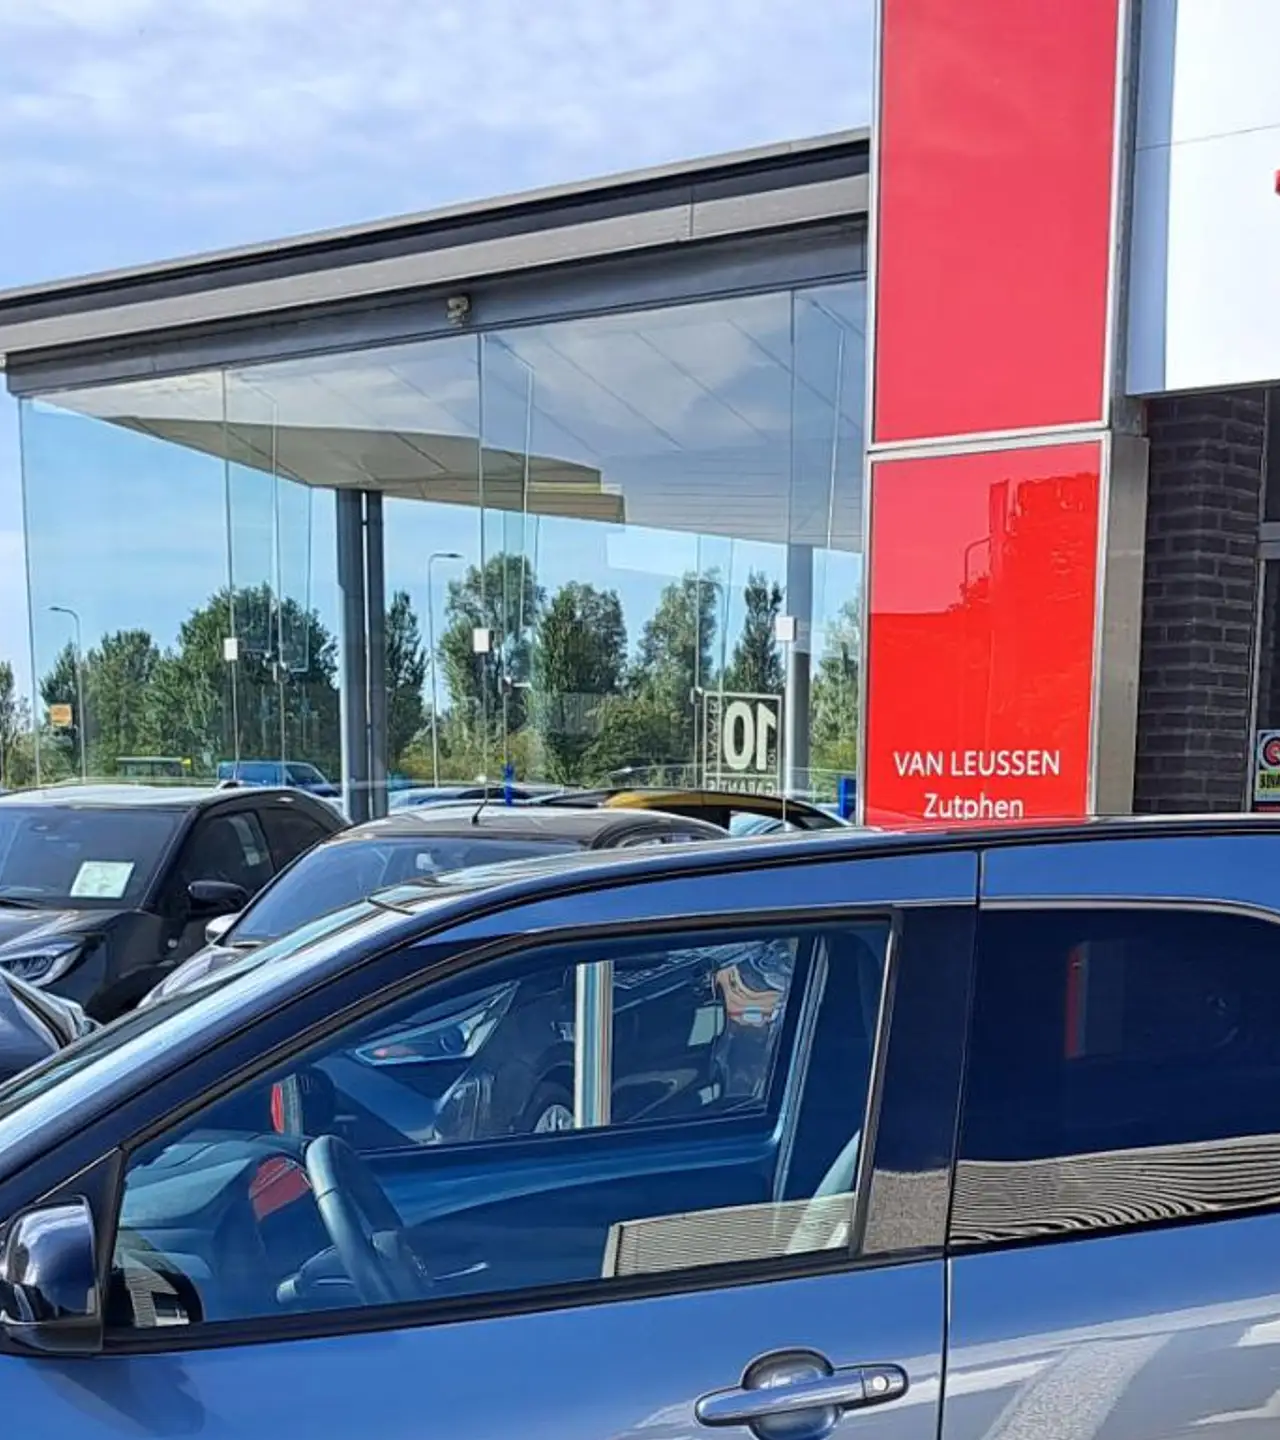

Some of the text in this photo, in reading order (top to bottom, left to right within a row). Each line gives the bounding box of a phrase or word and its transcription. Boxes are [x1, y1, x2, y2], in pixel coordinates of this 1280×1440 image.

[893, 750, 1061, 777] VAN LEUSSEN
[923, 790, 1024, 820] Zutphen
